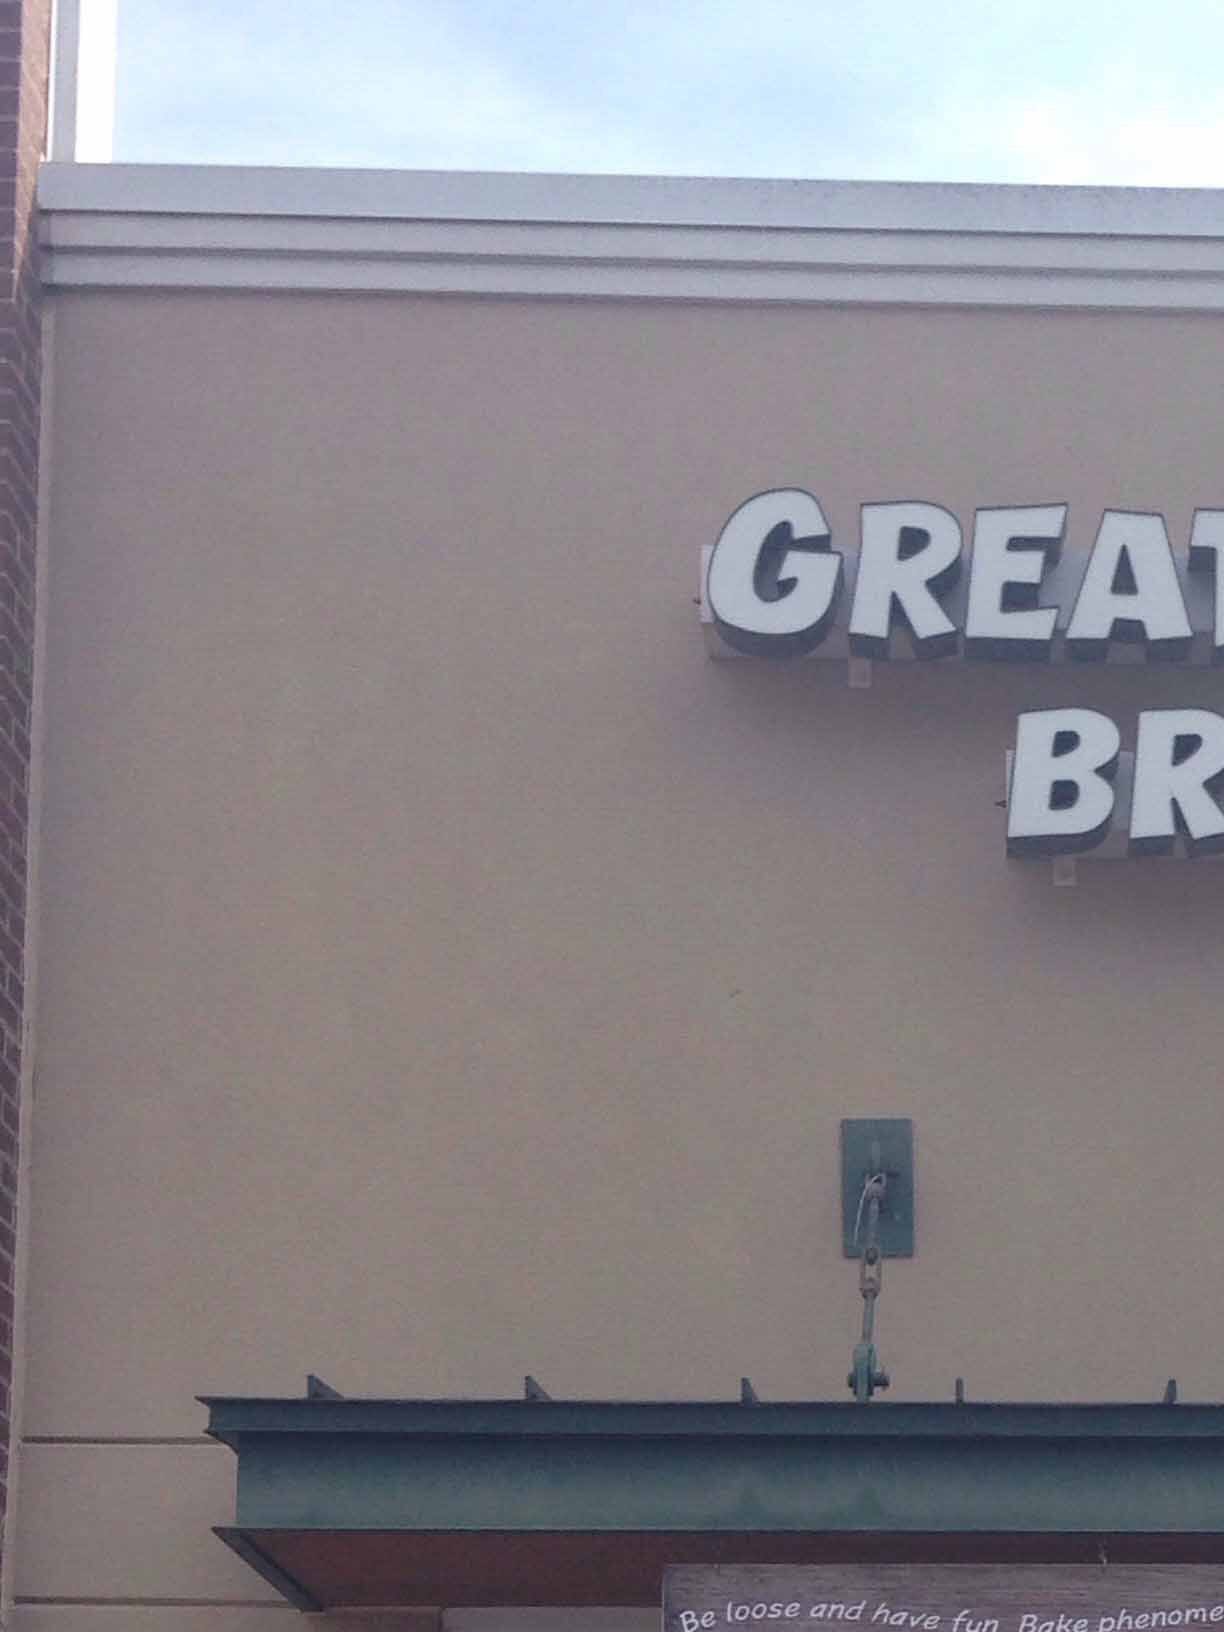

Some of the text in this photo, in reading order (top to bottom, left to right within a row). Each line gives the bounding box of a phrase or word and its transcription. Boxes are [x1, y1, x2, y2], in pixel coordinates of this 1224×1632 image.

[725, 1597, 801, 1624] loose
[809, 1595, 867, 1622] and
[872, 1604, 940, 1632] have
